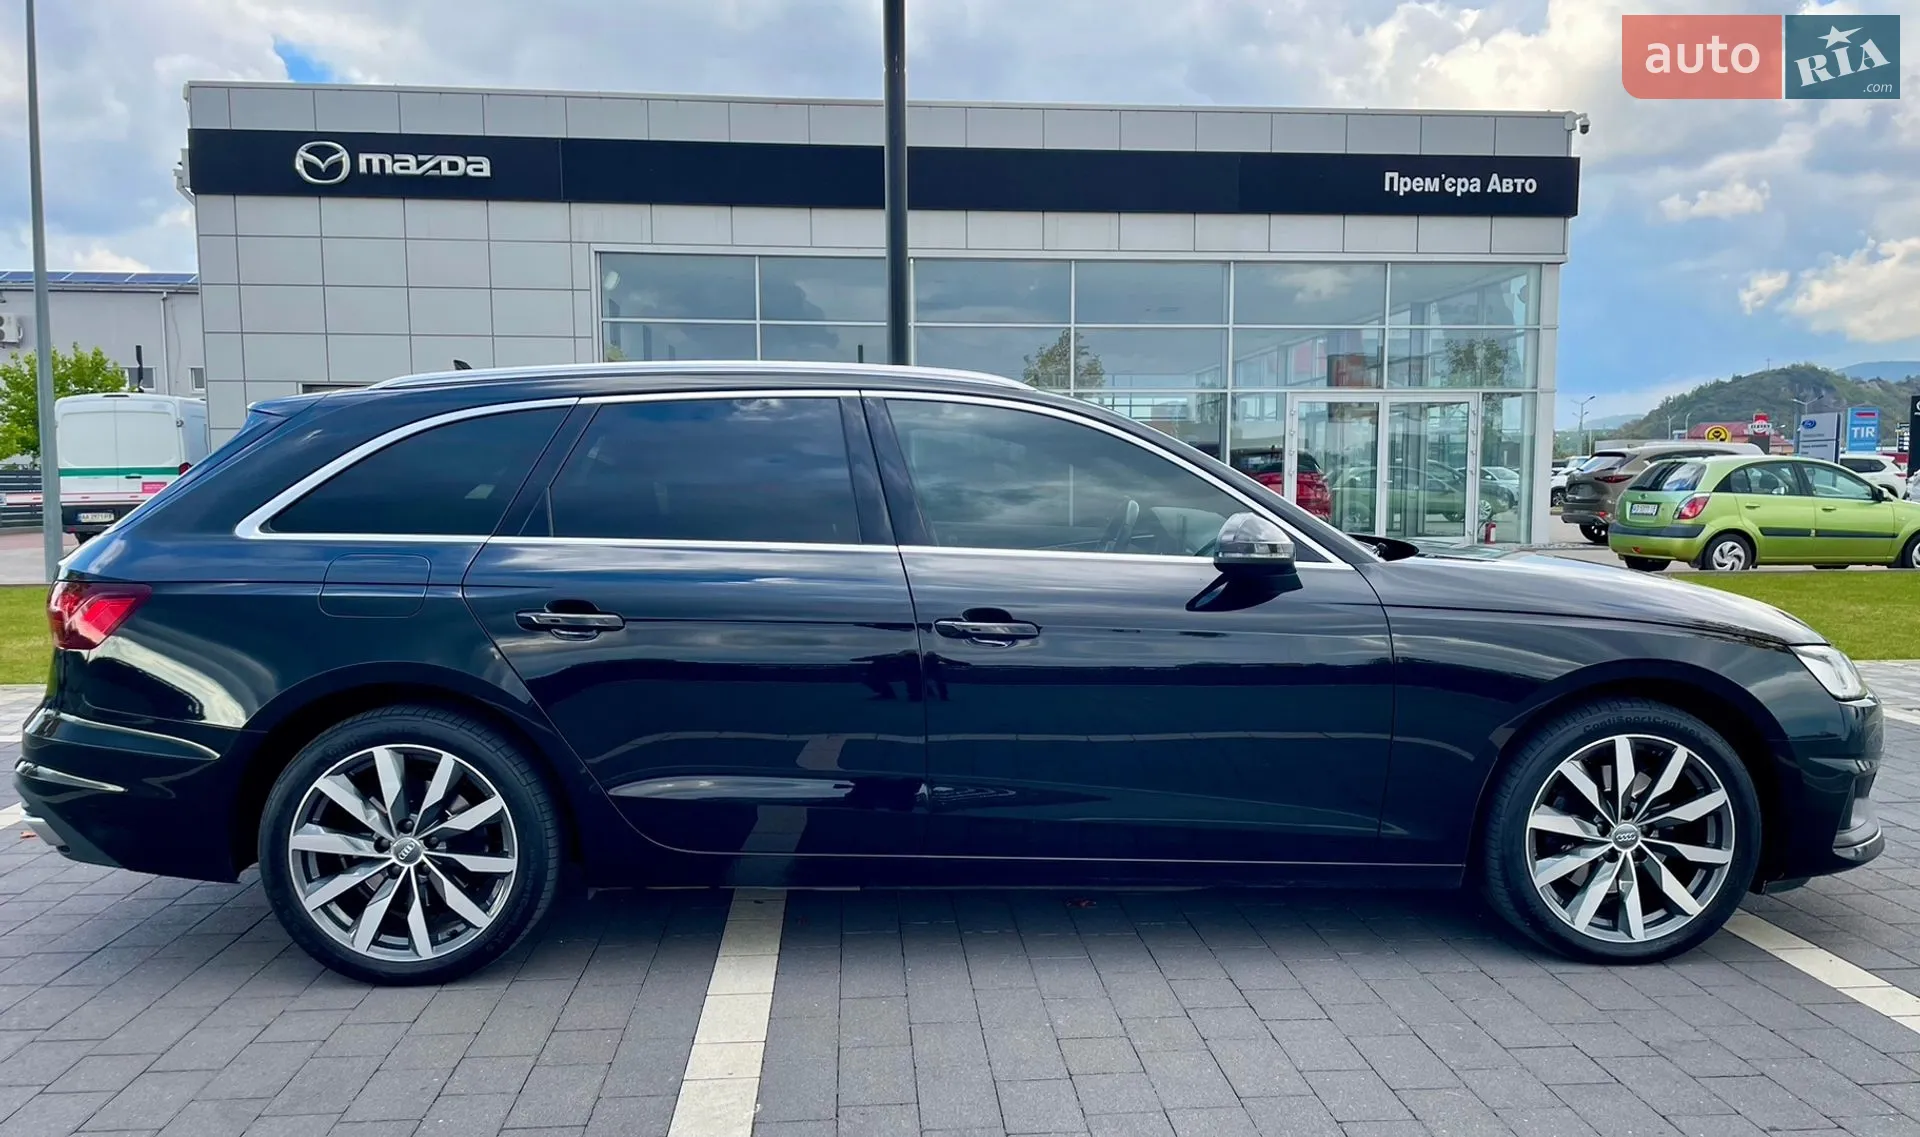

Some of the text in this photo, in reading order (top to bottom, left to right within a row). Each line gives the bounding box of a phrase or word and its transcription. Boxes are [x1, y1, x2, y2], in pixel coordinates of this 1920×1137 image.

[358, 152, 492, 178] mazda
[1384, 171, 1538, 197] Прем'єра Авто
[1851, 426, 1876, 438] TIR
